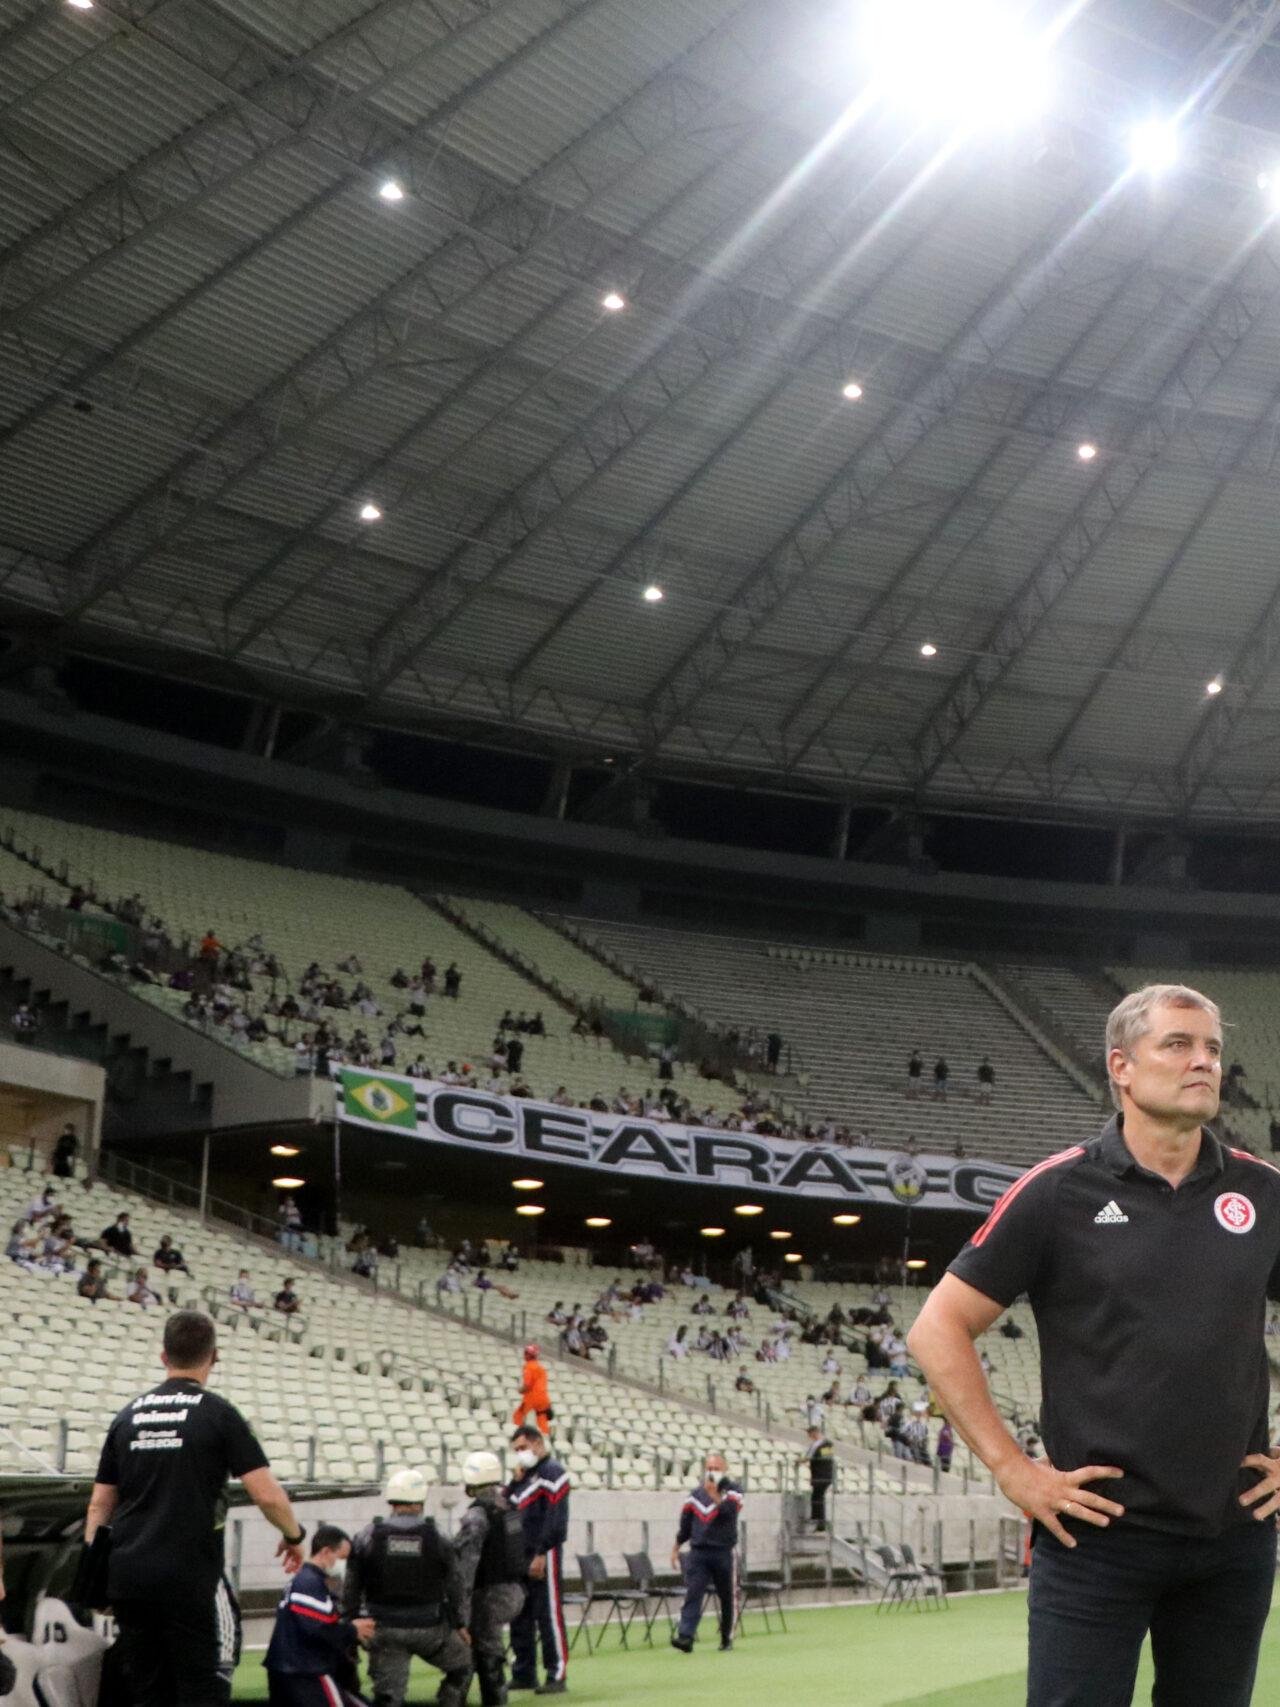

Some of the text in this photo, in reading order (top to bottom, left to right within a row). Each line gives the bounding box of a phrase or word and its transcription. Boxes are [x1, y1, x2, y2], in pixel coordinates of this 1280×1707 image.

[1094, 1214, 1129, 1224] adidas
[143, 1391, 203, 1406] Banrisul
[132, 1408, 188, 1425] Unimed
